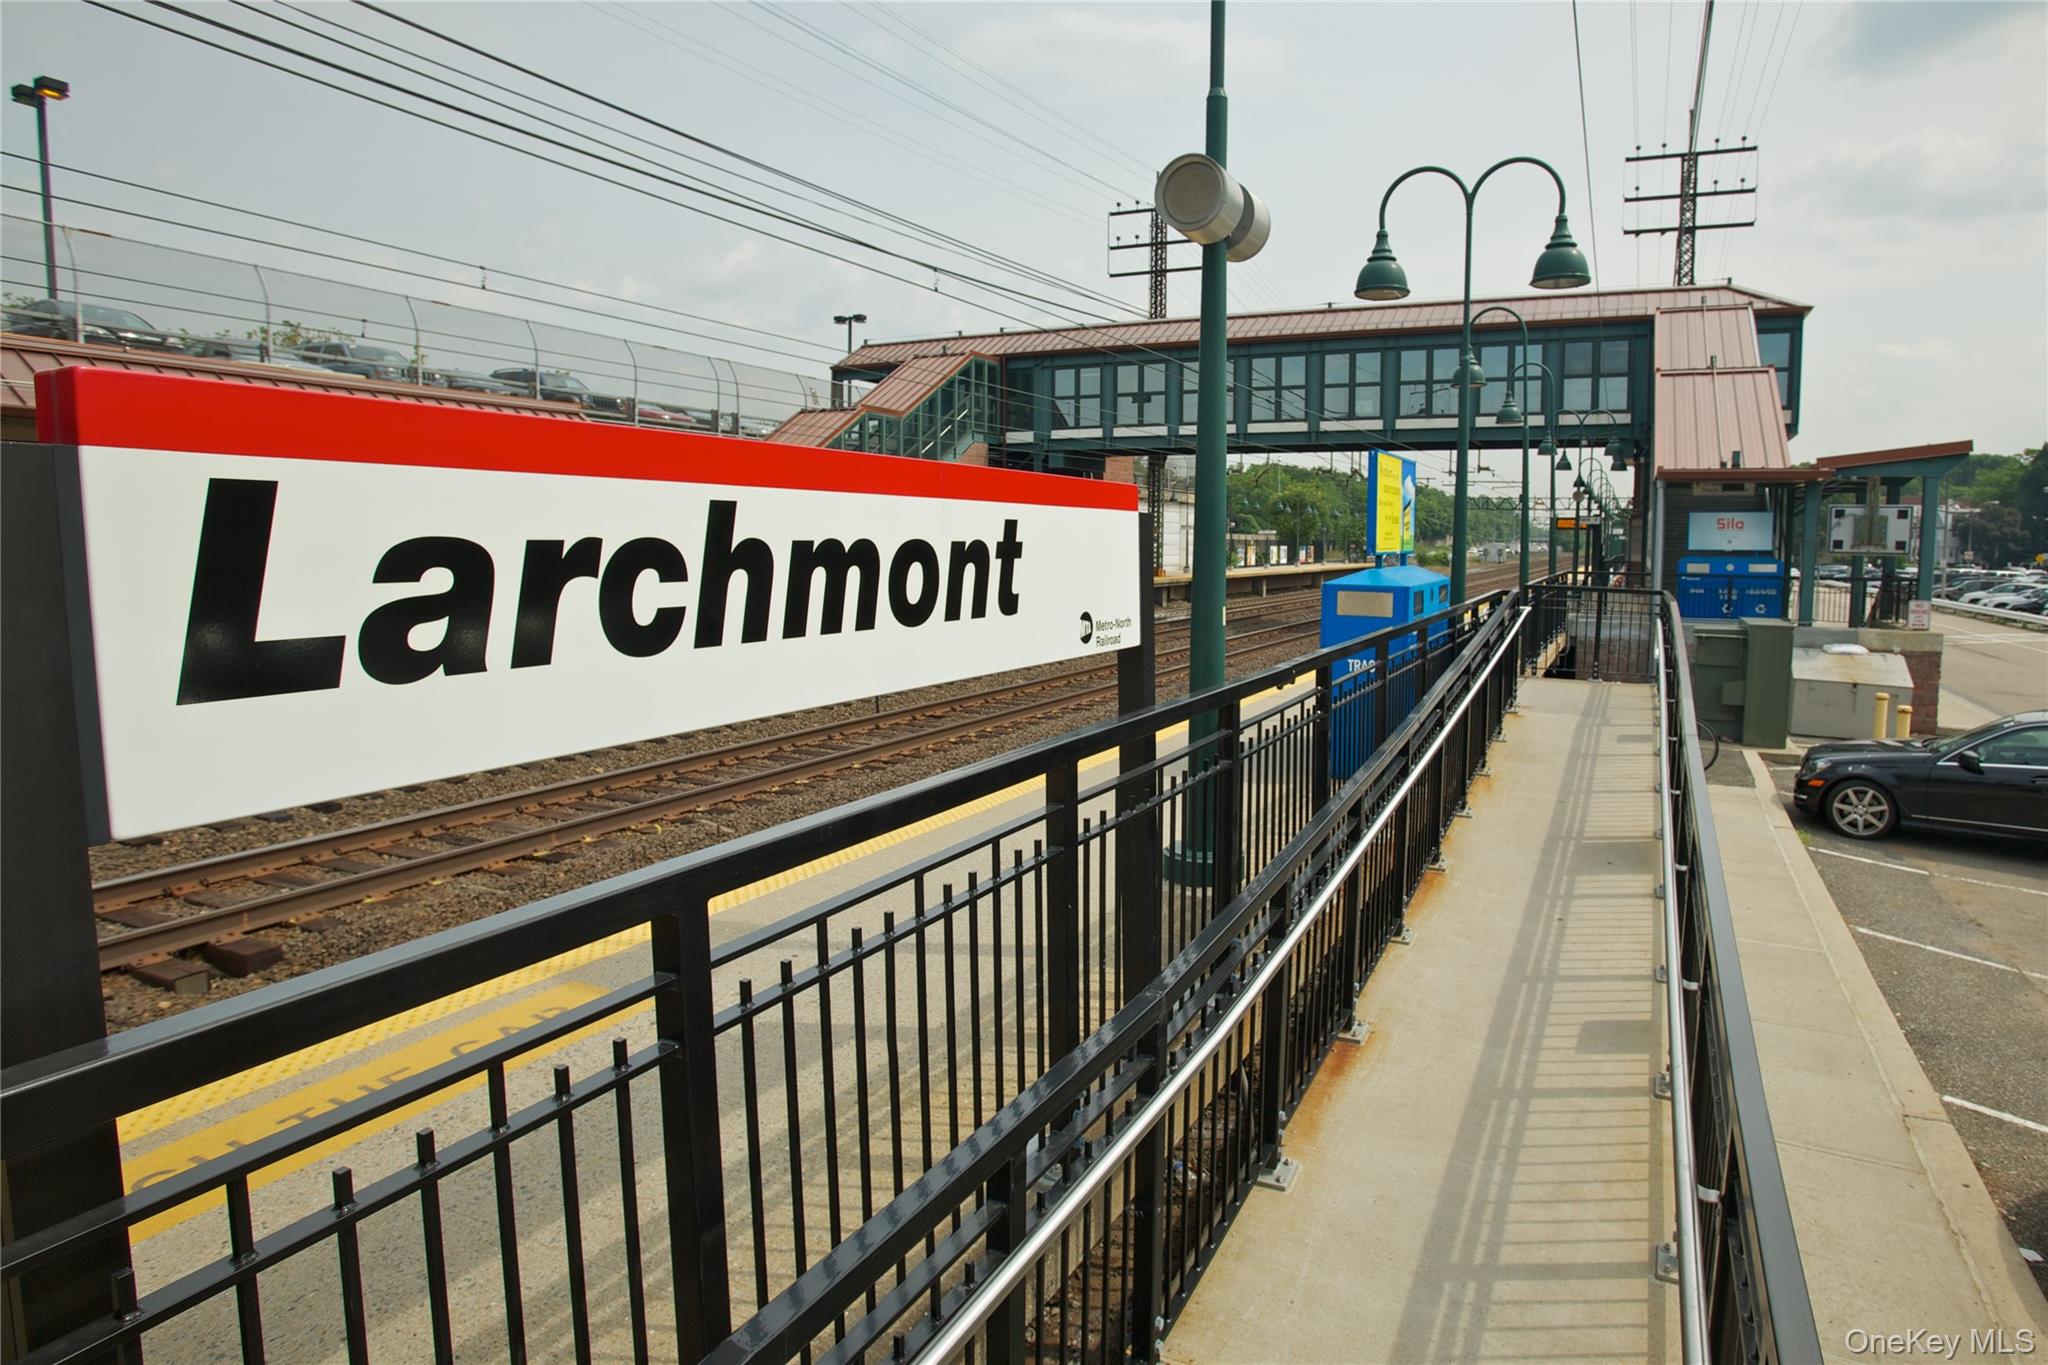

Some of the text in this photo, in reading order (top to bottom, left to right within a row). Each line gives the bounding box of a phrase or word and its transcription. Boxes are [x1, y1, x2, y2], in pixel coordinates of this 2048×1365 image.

[1717, 518, 1744, 530] Sila
[176, 478, 1023, 706] Larchmont
[1095, 617, 1132, 632] Metro-North
[1096, 633, 1121, 648] Railroad
[1347, 659, 1377, 673] TRAS
